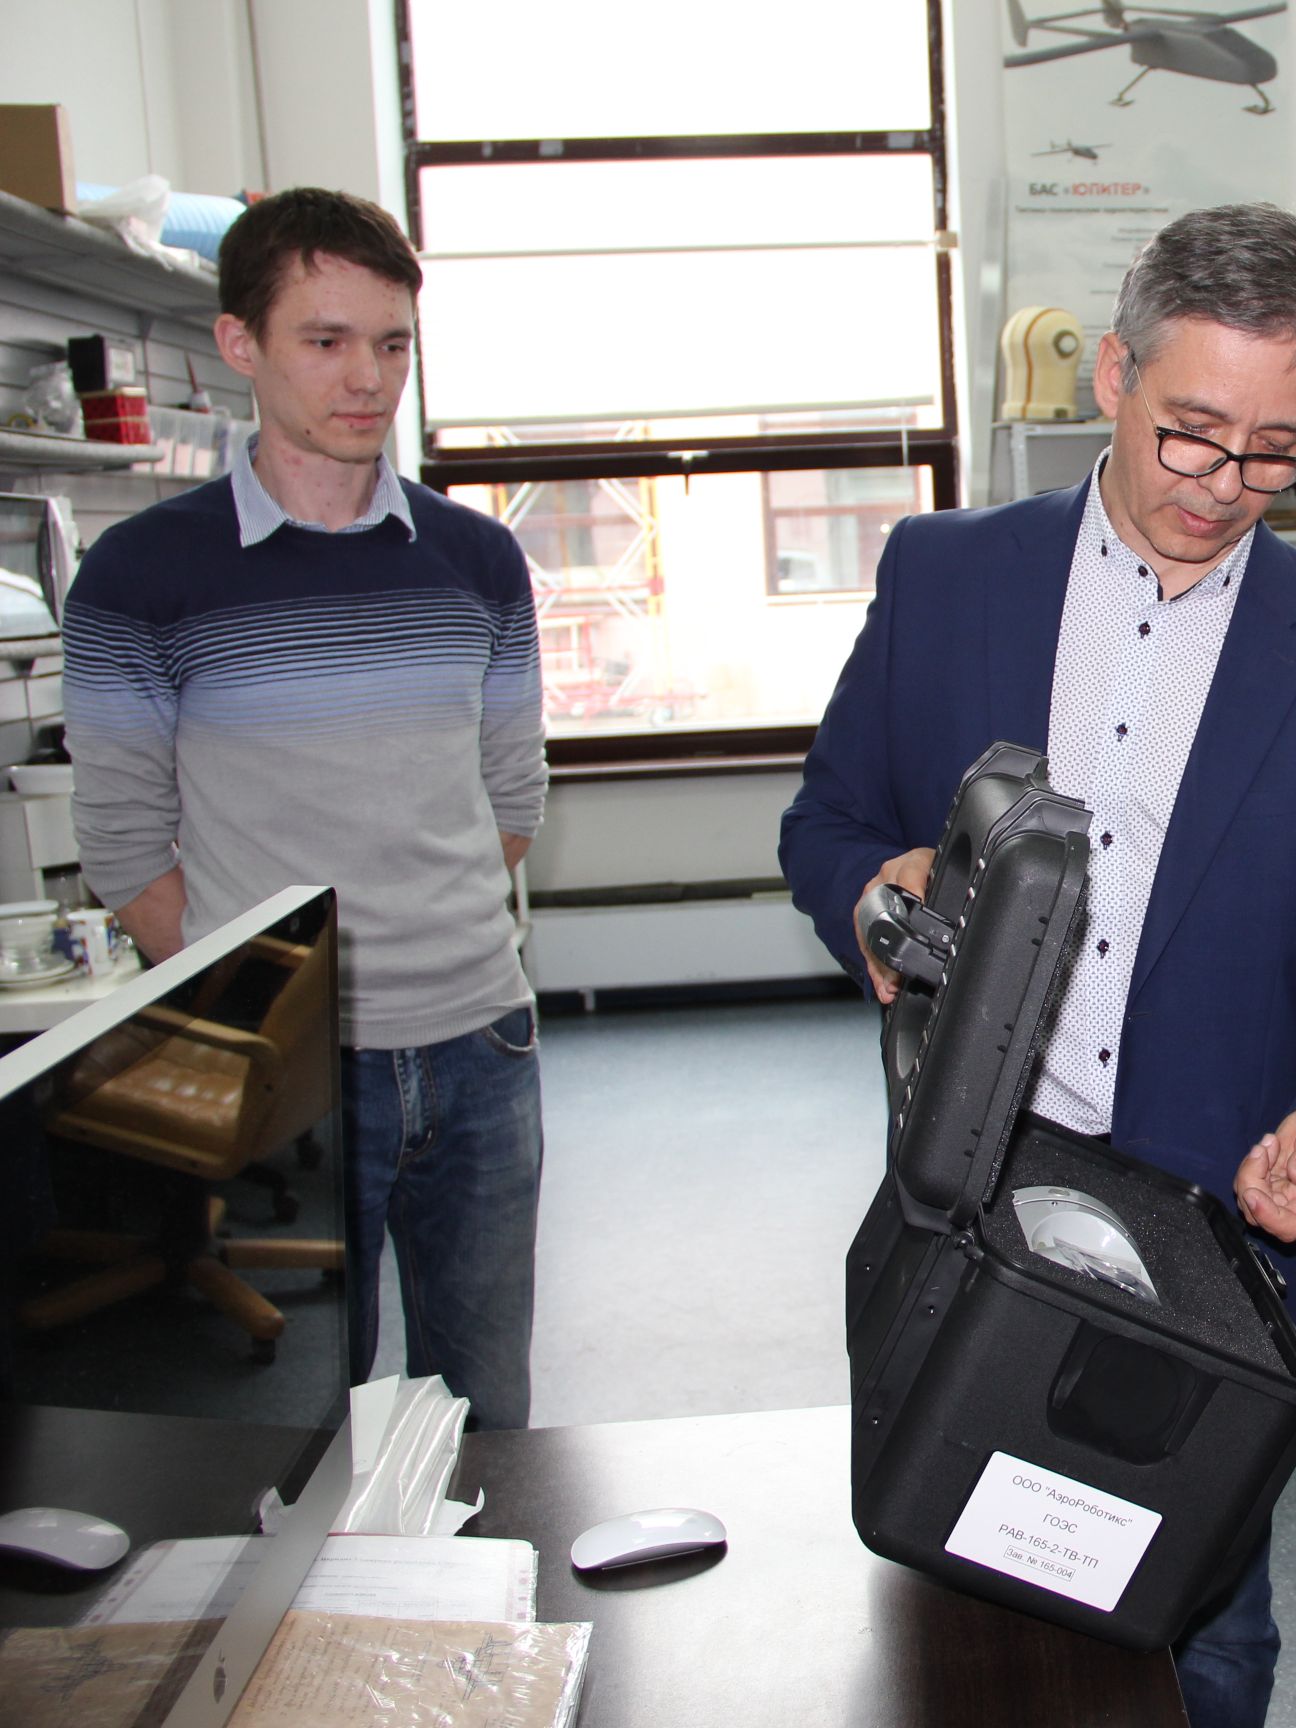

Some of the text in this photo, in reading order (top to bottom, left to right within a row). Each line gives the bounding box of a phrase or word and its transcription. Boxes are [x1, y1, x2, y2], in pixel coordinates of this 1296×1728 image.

[1029, 182, 1059, 196] БАС
[1012, 1475, 1132, 1527] ООО "АэроРоботикс"
[1043, 1513, 1078, 1534] ГОЭС
[1040, 1560, 1073, 1578] 165-004
